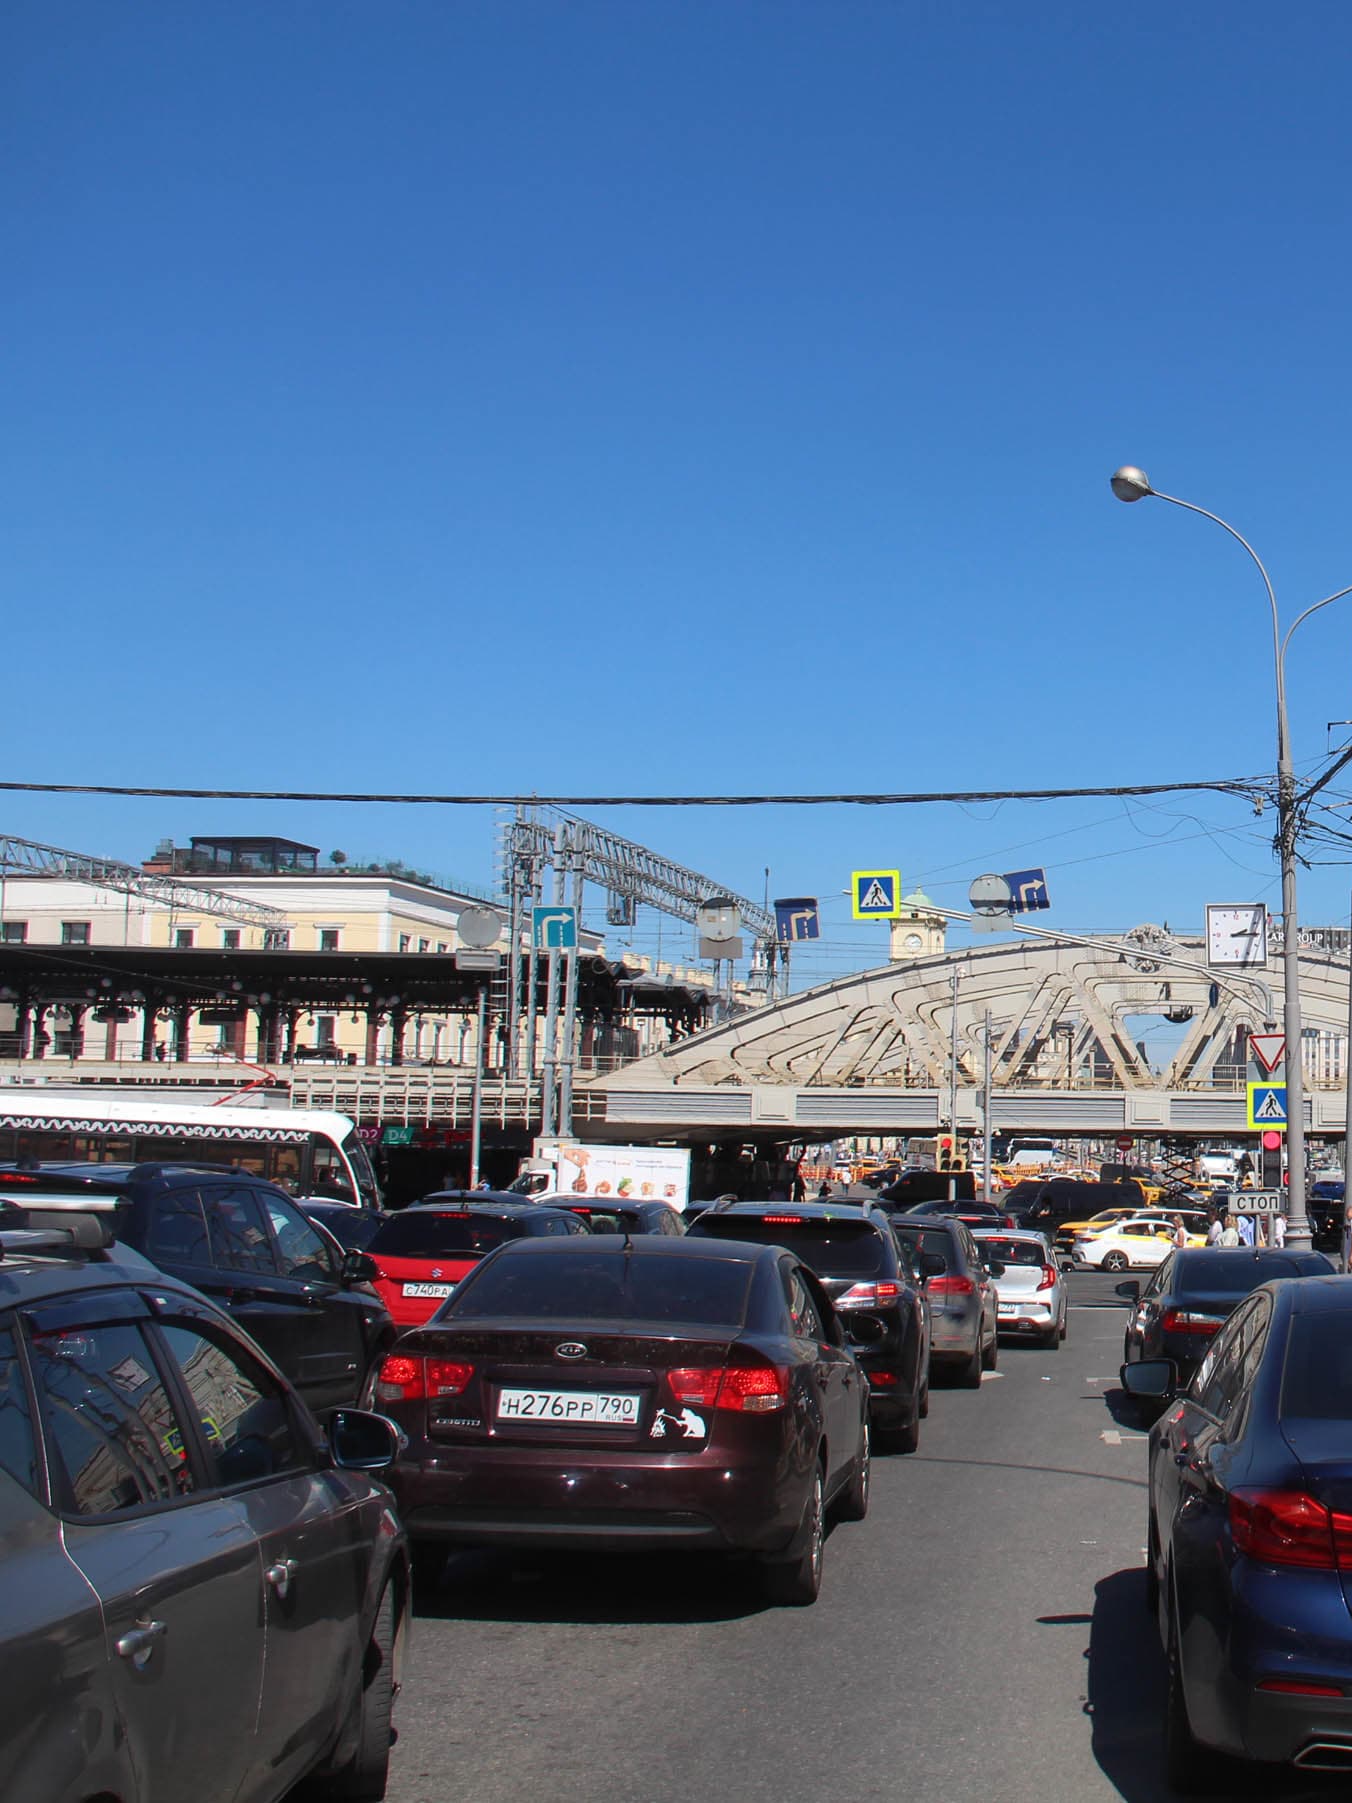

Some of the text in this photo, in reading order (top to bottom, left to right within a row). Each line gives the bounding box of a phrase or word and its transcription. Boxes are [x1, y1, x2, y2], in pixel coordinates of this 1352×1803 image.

[359, 1128, 408, 1141] D2 D4
[1236, 1196, 1278, 1209] СТОП
[506, 1394, 633, 1417] Н276РР 790
